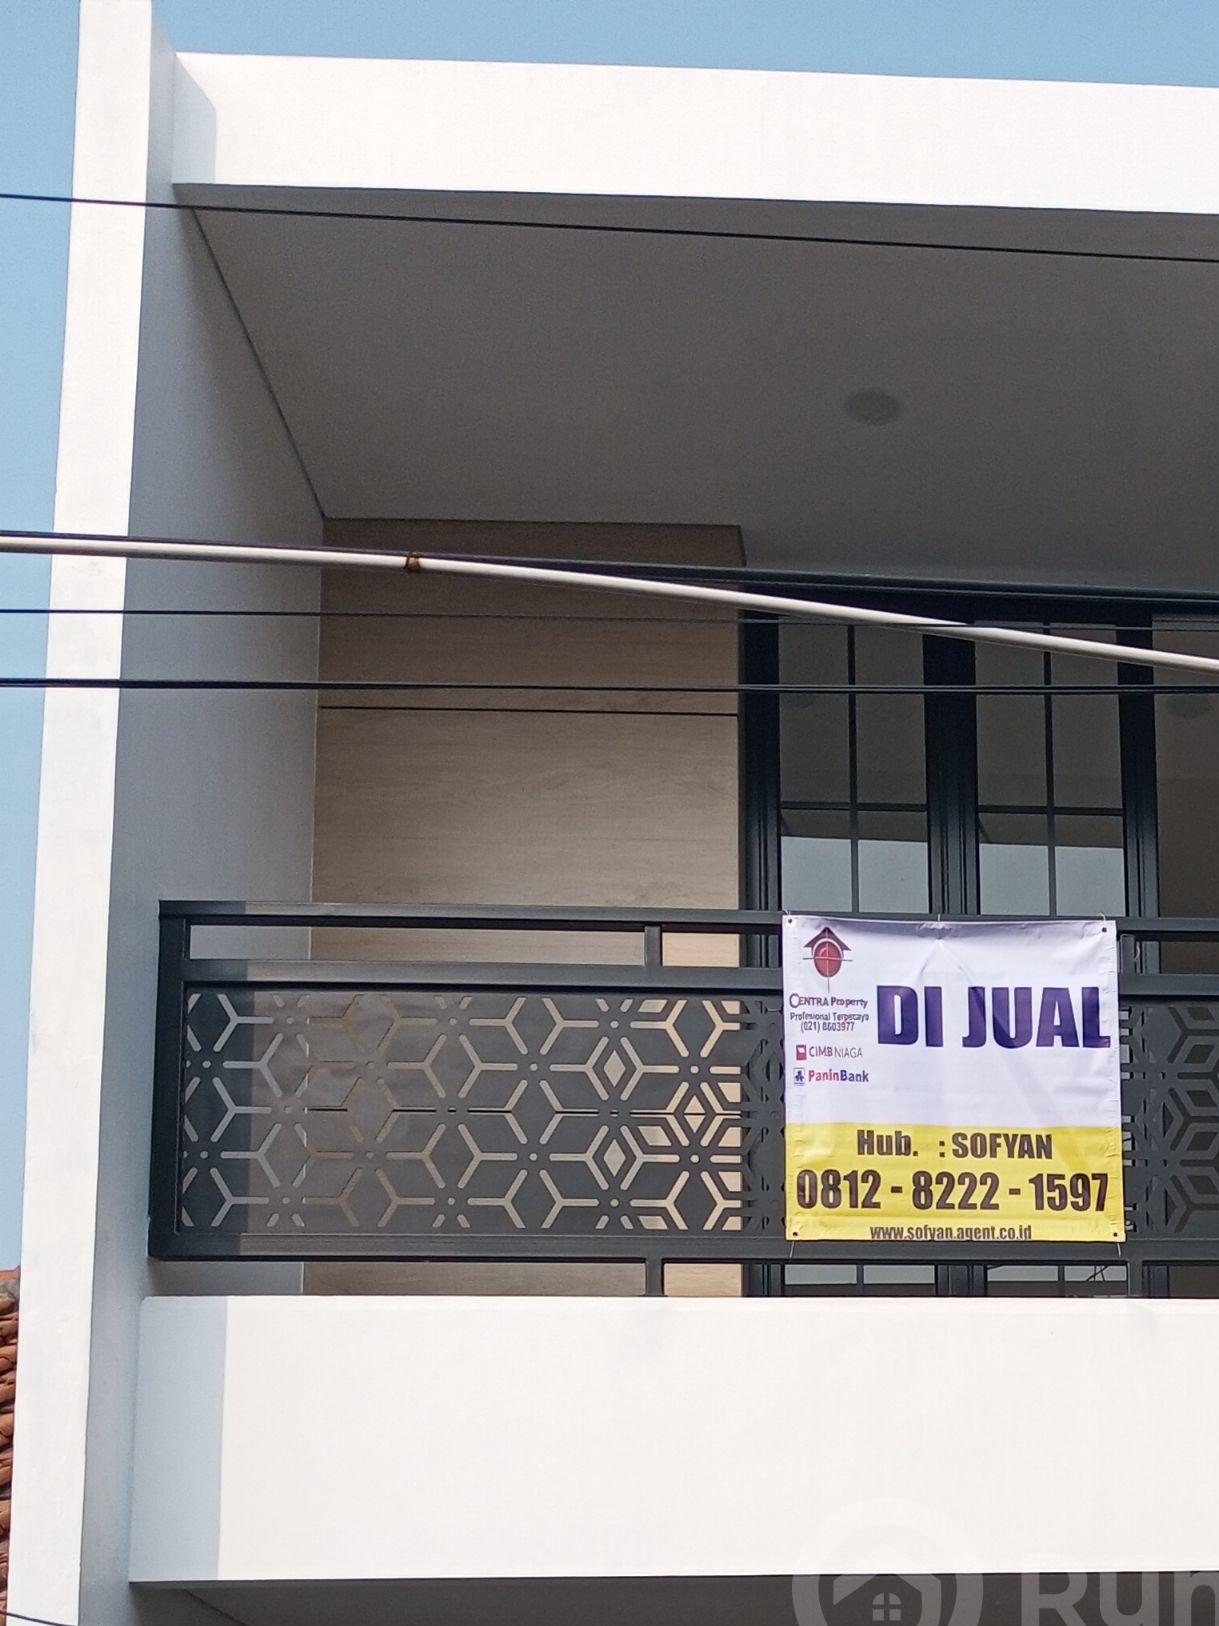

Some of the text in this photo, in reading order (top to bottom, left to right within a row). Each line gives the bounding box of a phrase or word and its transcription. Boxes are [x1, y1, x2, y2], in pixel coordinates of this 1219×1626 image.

[789, 993, 868, 1009] CENTRA Property
[876, 984, 1112, 1049] DI JUAL
[801, 1021, 820, 1033] (021)
[809, 1046, 863, 1058] CIMB NIAGA
[808, 1068, 869, 1082] PaninBank
[857, 1129, 919, 1157] Hub.
[951, 1133, 1053, 1160] SOFYAN
[869, 1224, 1032, 1240] www.sofyan.agent.co.id
